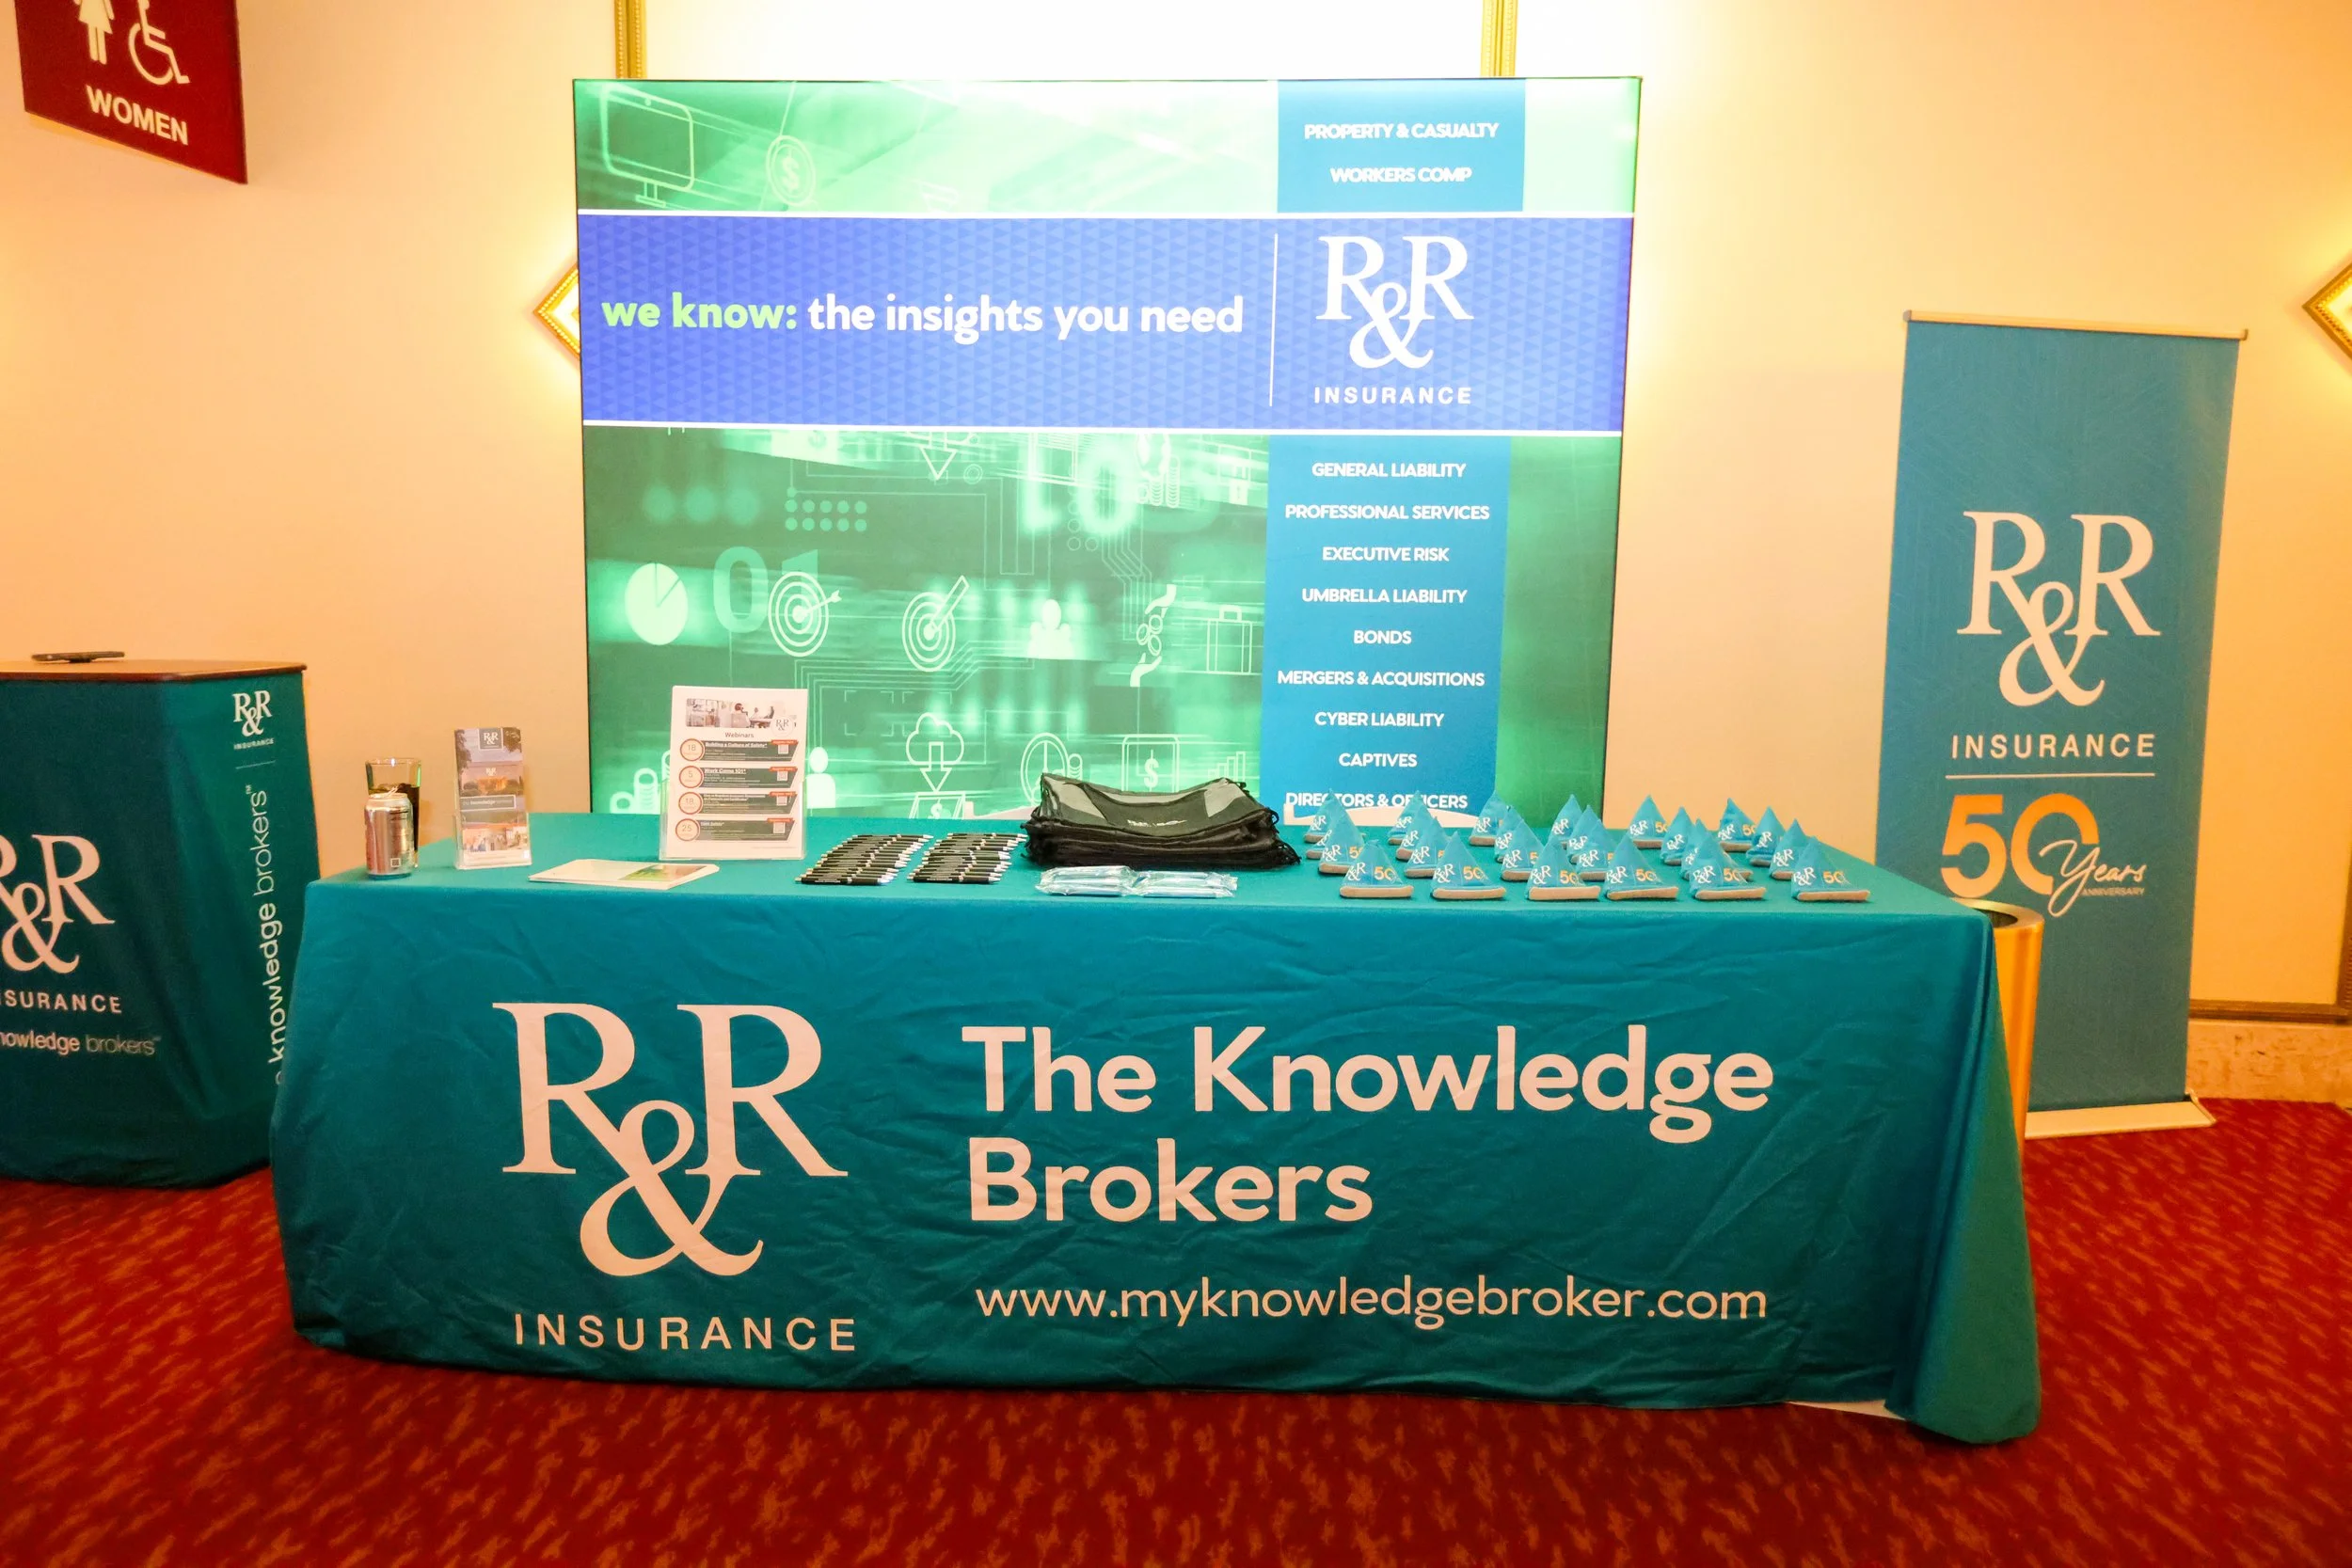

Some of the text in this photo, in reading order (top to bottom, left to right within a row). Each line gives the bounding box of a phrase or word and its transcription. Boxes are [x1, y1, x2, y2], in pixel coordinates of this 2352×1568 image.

[86, 85, 188, 146] WOMEN
[1304, 123, 1499, 139] PROPERTY & CASUALTY
[1329, 166, 1472, 182] WORKERS COMP
[1315, 236, 1474, 369] R&R
[601, 292, 1243, 345] we know: the insights you need
[1314, 387, 1471, 404] INSURANCE
[1311, 463, 1466, 478] GENERAL LIABILITY
[1285, 504, 1490, 520] PROFESSIONAL SERVICES
[1323, 546, 1450, 562] EXECUTIVE RISK
[1302, 588, 1468, 603] UMBRELLA LIABILITY
[1957, 511, 2161, 706] R&R
[1353, 630, 1412, 644] BONDS
[1278, 671, 1486, 687] MERGERS & ACQUISITIONS
[232, 690, 272, 736] R&R
[1314, 712, 1444, 727] CYBER LIABILITY
[1950, 734, 2156, 759] INSURANCE
[1339, 752, 1418, 768] CAPTIVES
[1376, 793, 1389, 806] &
[1391, 794, 1469, 809] OFICERS
[1941, 793, 2147, 917] 50 Years
[0, 833, 116, 974] &R
[259, 902, 286, 1063] knowledge
[0, 990, 121, 1014] SURANCE
[961, 1024, 1774, 1144] The Knowledge
[492, 1002, 850, 1276] R&R
[969, 1137, 1374, 1222] Brokers
[976, 1274, 1767, 1331] www.myknowledgebroker.com
[514, 1313, 855, 1351] INSURANCE
